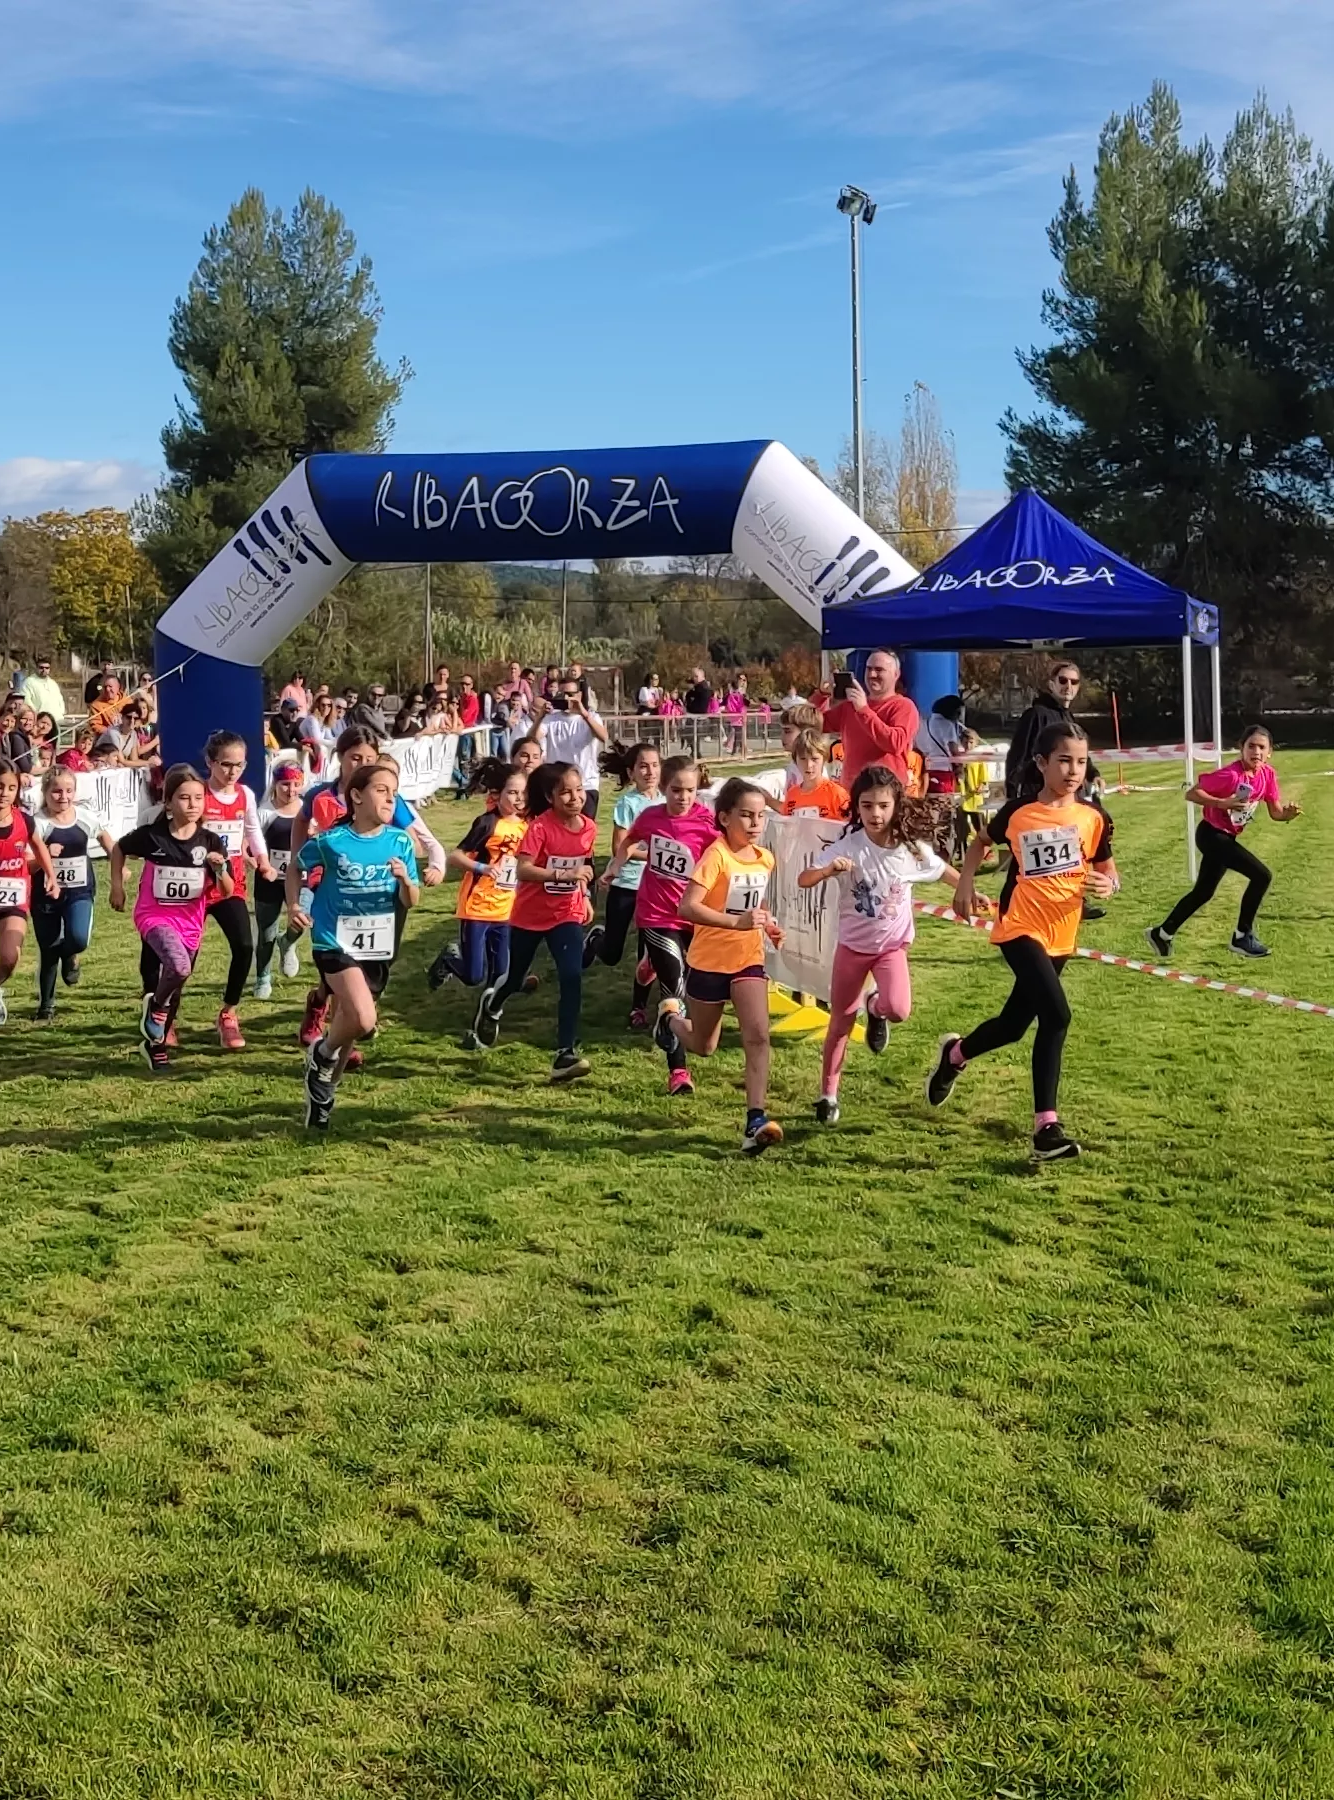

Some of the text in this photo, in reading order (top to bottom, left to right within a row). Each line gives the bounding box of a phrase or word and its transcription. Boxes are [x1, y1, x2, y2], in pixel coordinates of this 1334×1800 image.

[374, 466, 684, 536] RIBAGORZA
[906, 561, 1115, 594] RIBAGORZA
[655, 851, 687, 874] 143
[1030, 843, 1072, 868] 134
[56, 869, 76, 882] 48
[166, 882, 190, 898] 60
[351, 932, 375, 950] 41
